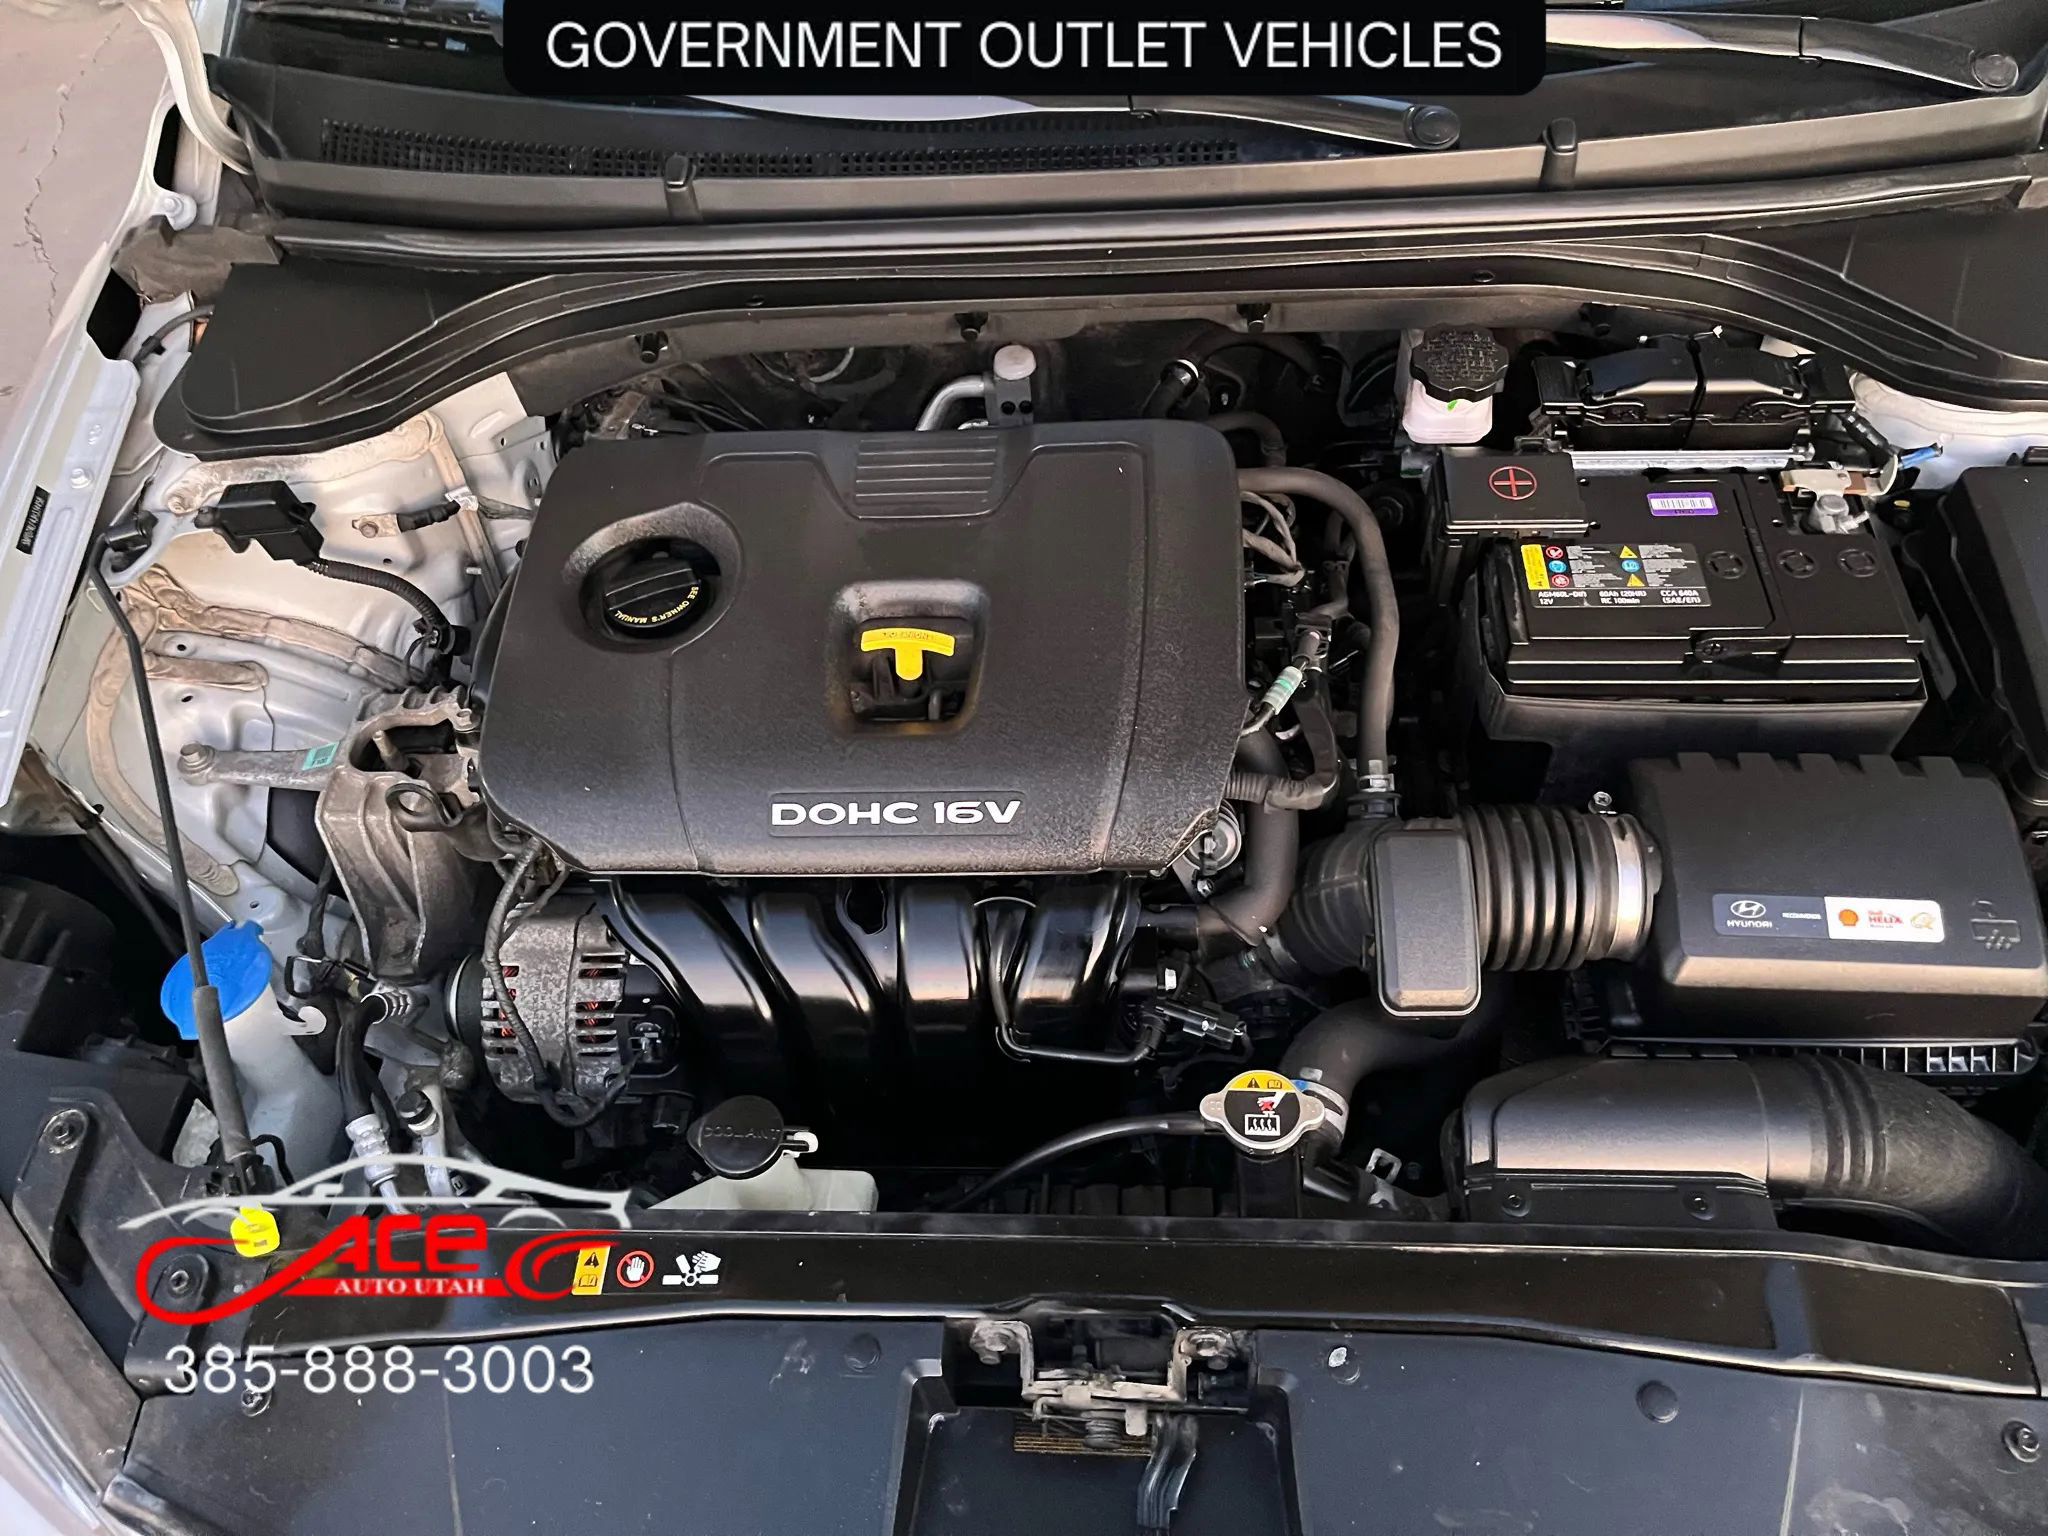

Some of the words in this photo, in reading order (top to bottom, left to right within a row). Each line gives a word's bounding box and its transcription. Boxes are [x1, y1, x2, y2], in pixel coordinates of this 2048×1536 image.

[687, 586, 699, 600] SEE
[614, 610, 648, 624] MANUAL
[651, 600, 690, 623] OWNER'S
[771, 801, 919, 826] DOHC
[933, 800, 1021, 824] 16V
[1726, 920, 1773, 928] HYUNDAI
